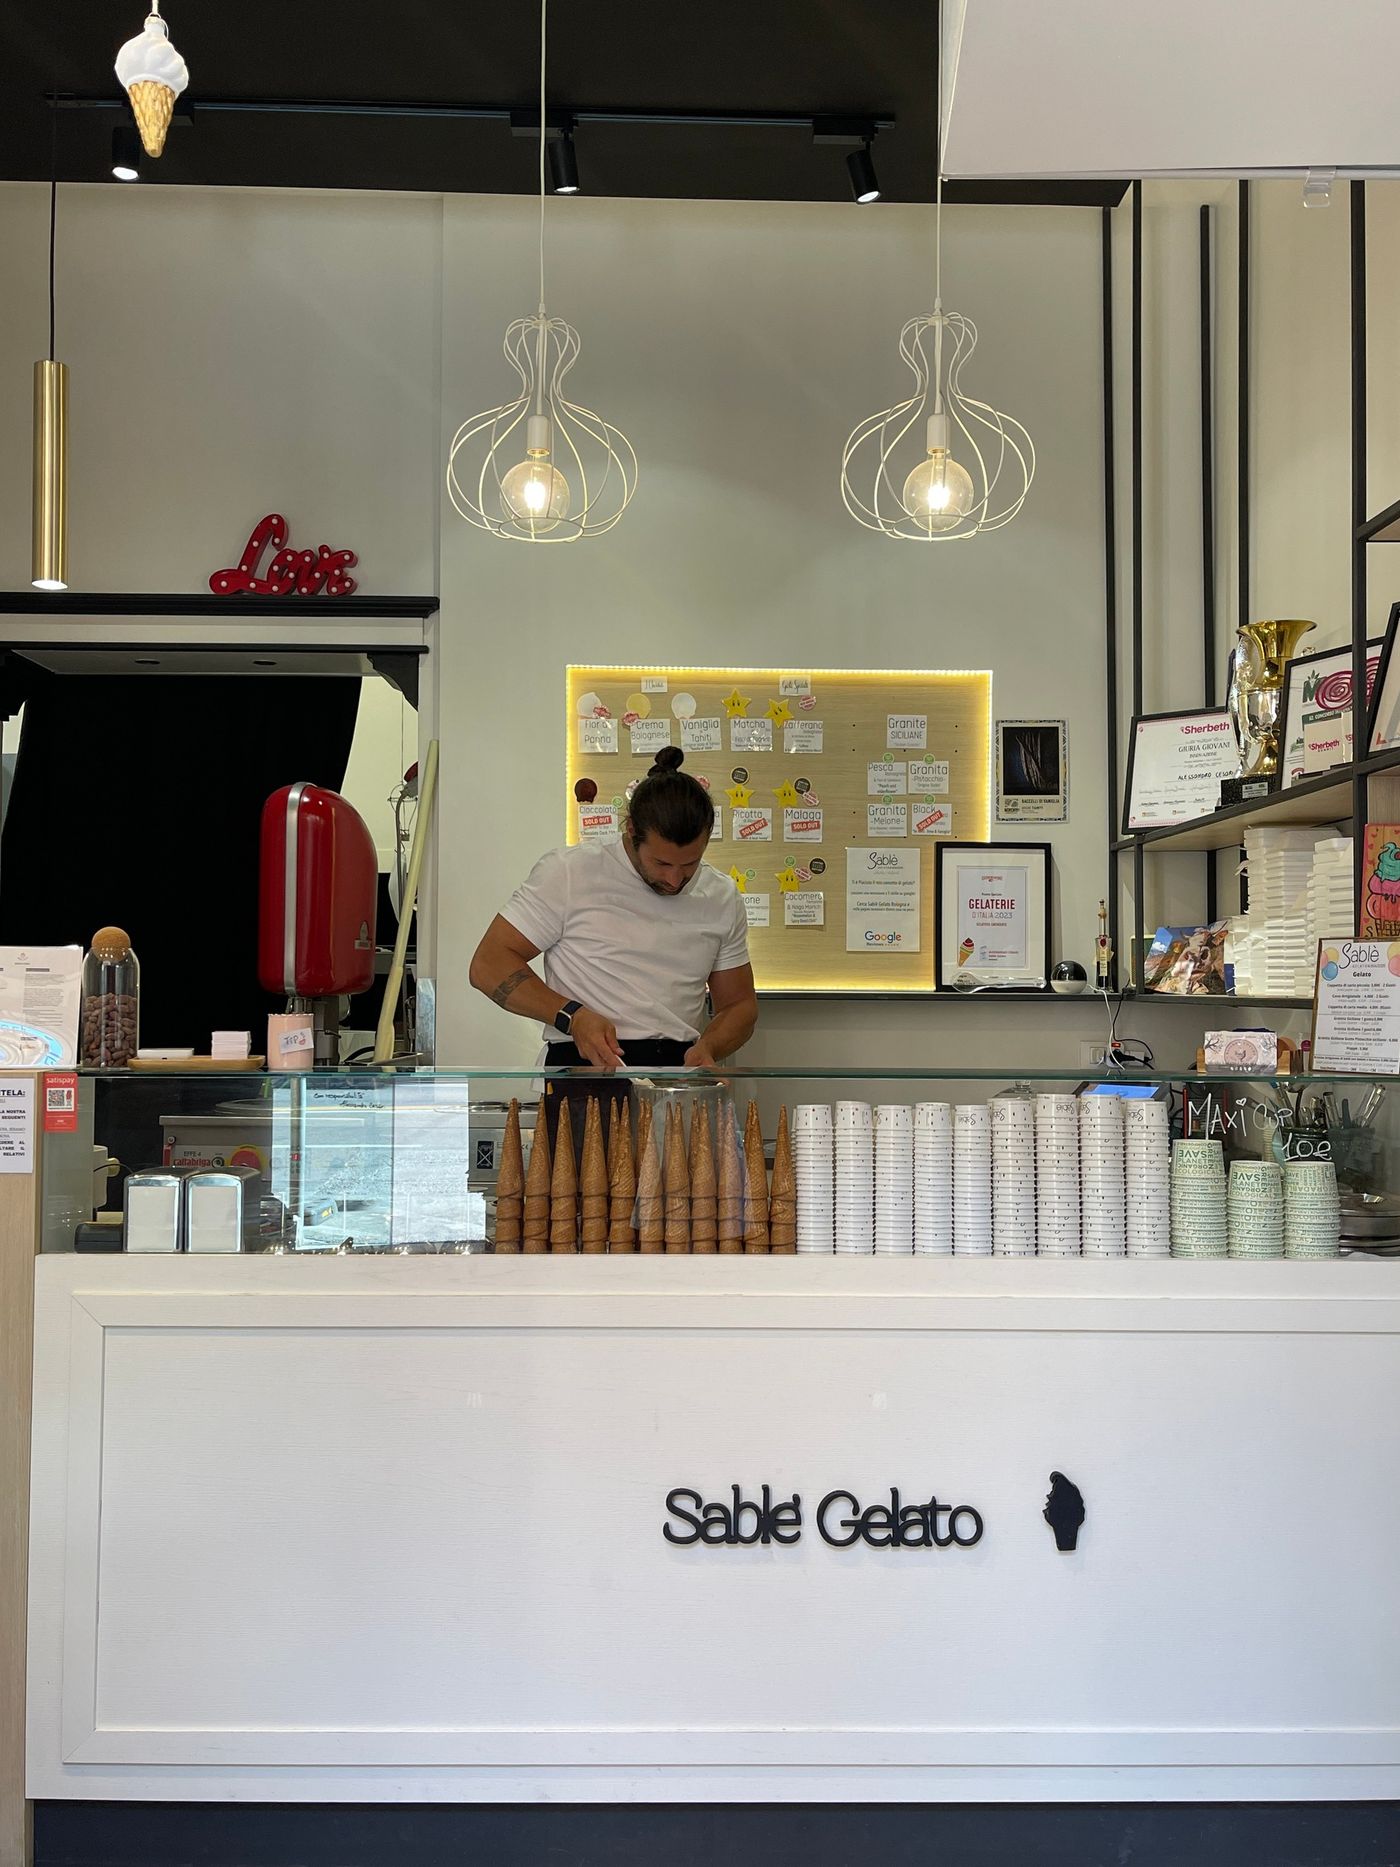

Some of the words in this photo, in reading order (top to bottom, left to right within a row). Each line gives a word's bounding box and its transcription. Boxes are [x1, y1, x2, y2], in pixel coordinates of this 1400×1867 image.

[209, 514, 358, 595] Love
[636, 720, 664, 730] Crema
[682, 719, 719, 732] Vaniglia
[733, 720, 766, 729] Matcha
[888, 717, 926, 729] Granite
[1184, 722, 1230, 735] Sherbeth
[584, 735, 611, 743] Panna
[631, 730, 670, 741] Bolognese
[691, 733, 712, 743] Tahiti
[891, 731, 922, 739] SICILIANE
[1178, 744, 1201, 753] GIURIA
[1202, 741, 1231, 750] GIOVANI
[1311, 739, 1340, 751] Sherbeth
[868, 763, 894, 772] Pesca
[910, 763, 948, 775] Granita
[579, 805, 617, 814] Cioccolato
[733, 810, 763, 819] Ricotta
[868, 805, 906, 816] Granita
[913, 804, 936, 814] Black
[785, 810, 821, 821] Malaga
[741, 825, 755, 836] SOLD
[754, 820, 765, 829] OUT
[918, 816, 931, 831] SOLD
[784, 892, 822, 900] Cocomero
[968, 898, 1015, 910] GELATERIE
[994, 911, 1013, 919] 2023
[864, 931, 902, 943] Google
[1339, 943, 1379, 969] Sablè
[46, 1077, 75, 1085] satispay
[1178, 1149, 1207, 1158] SAVE
[1233, 1171, 1260, 1181] SAVE
[1231, 1190, 1274, 1198] COLOGICAL
[816, 1487, 984, 1547] Gelato
